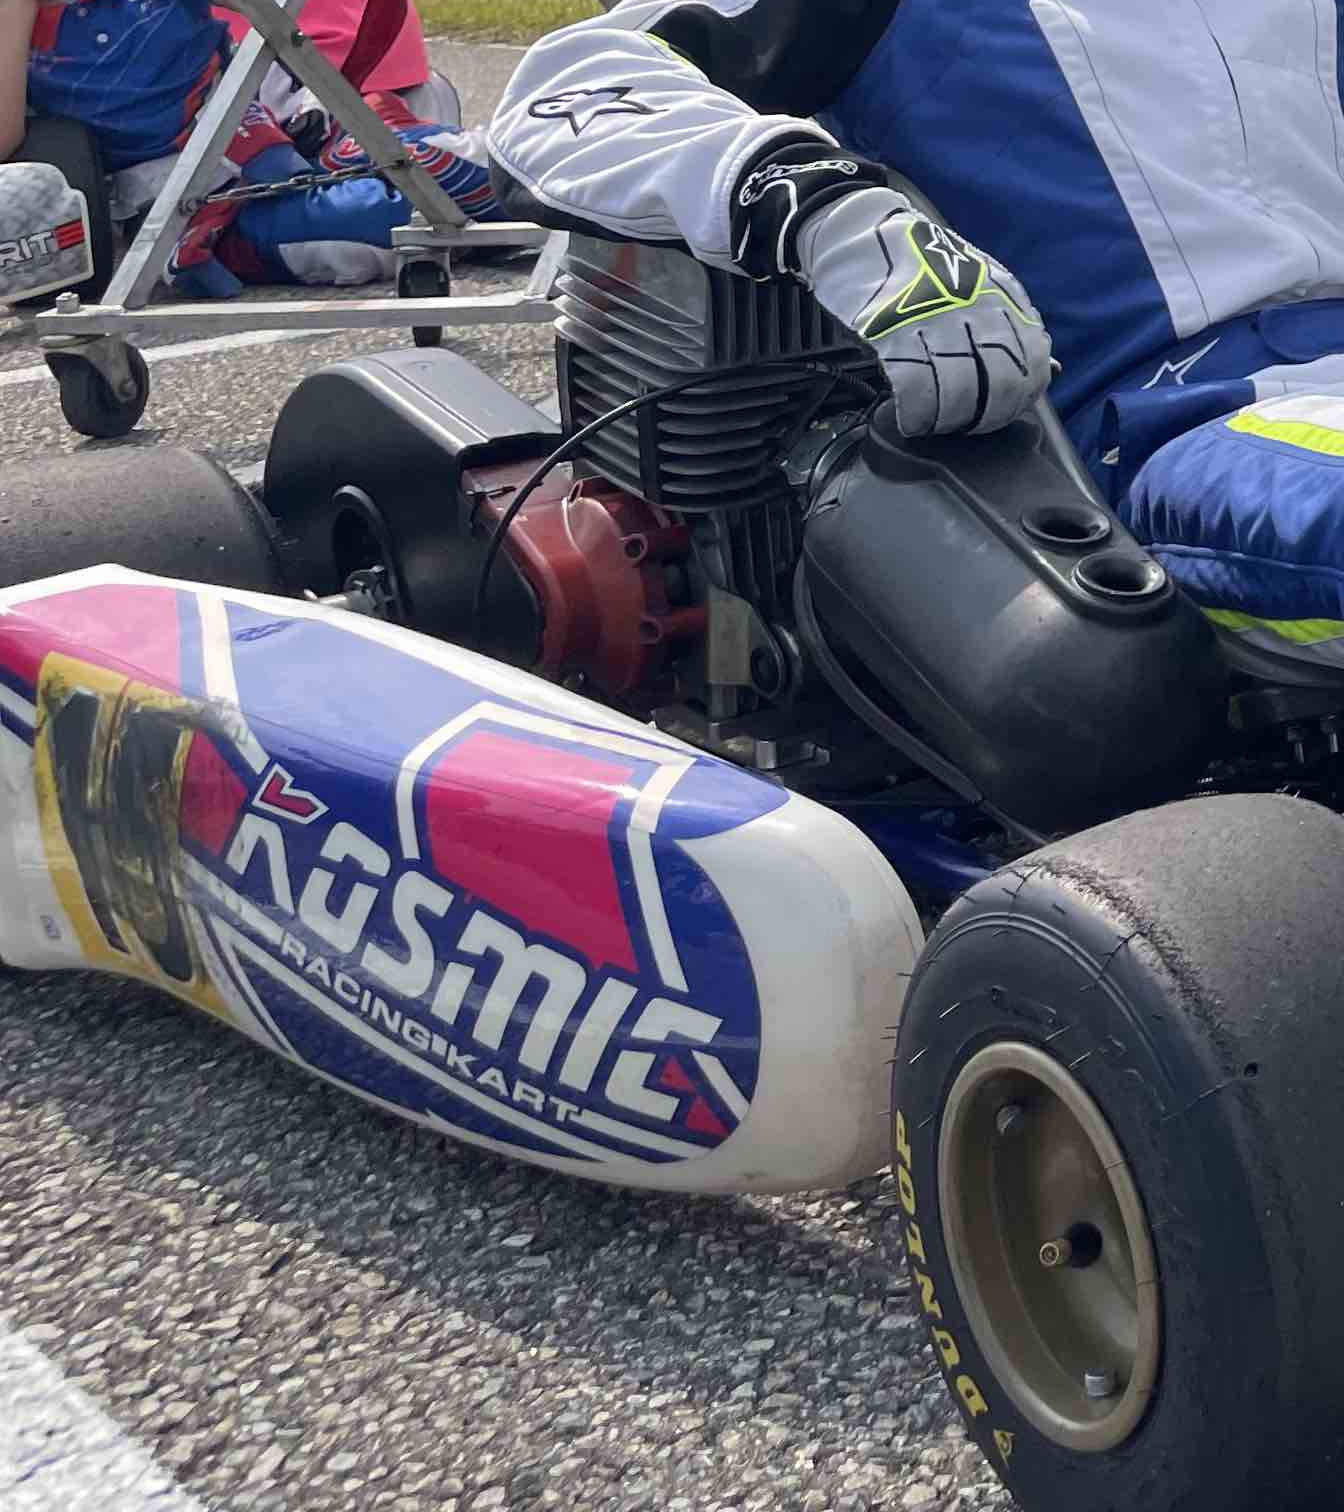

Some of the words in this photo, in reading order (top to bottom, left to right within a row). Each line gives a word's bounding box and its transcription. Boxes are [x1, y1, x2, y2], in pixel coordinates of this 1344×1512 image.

[226, 762, 724, 1123] KOSMIC
[280, 928, 448, 1059] RACING
[445, 1041, 584, 1123] KART
[896, 1109, 989, 1417] DUNLOP
